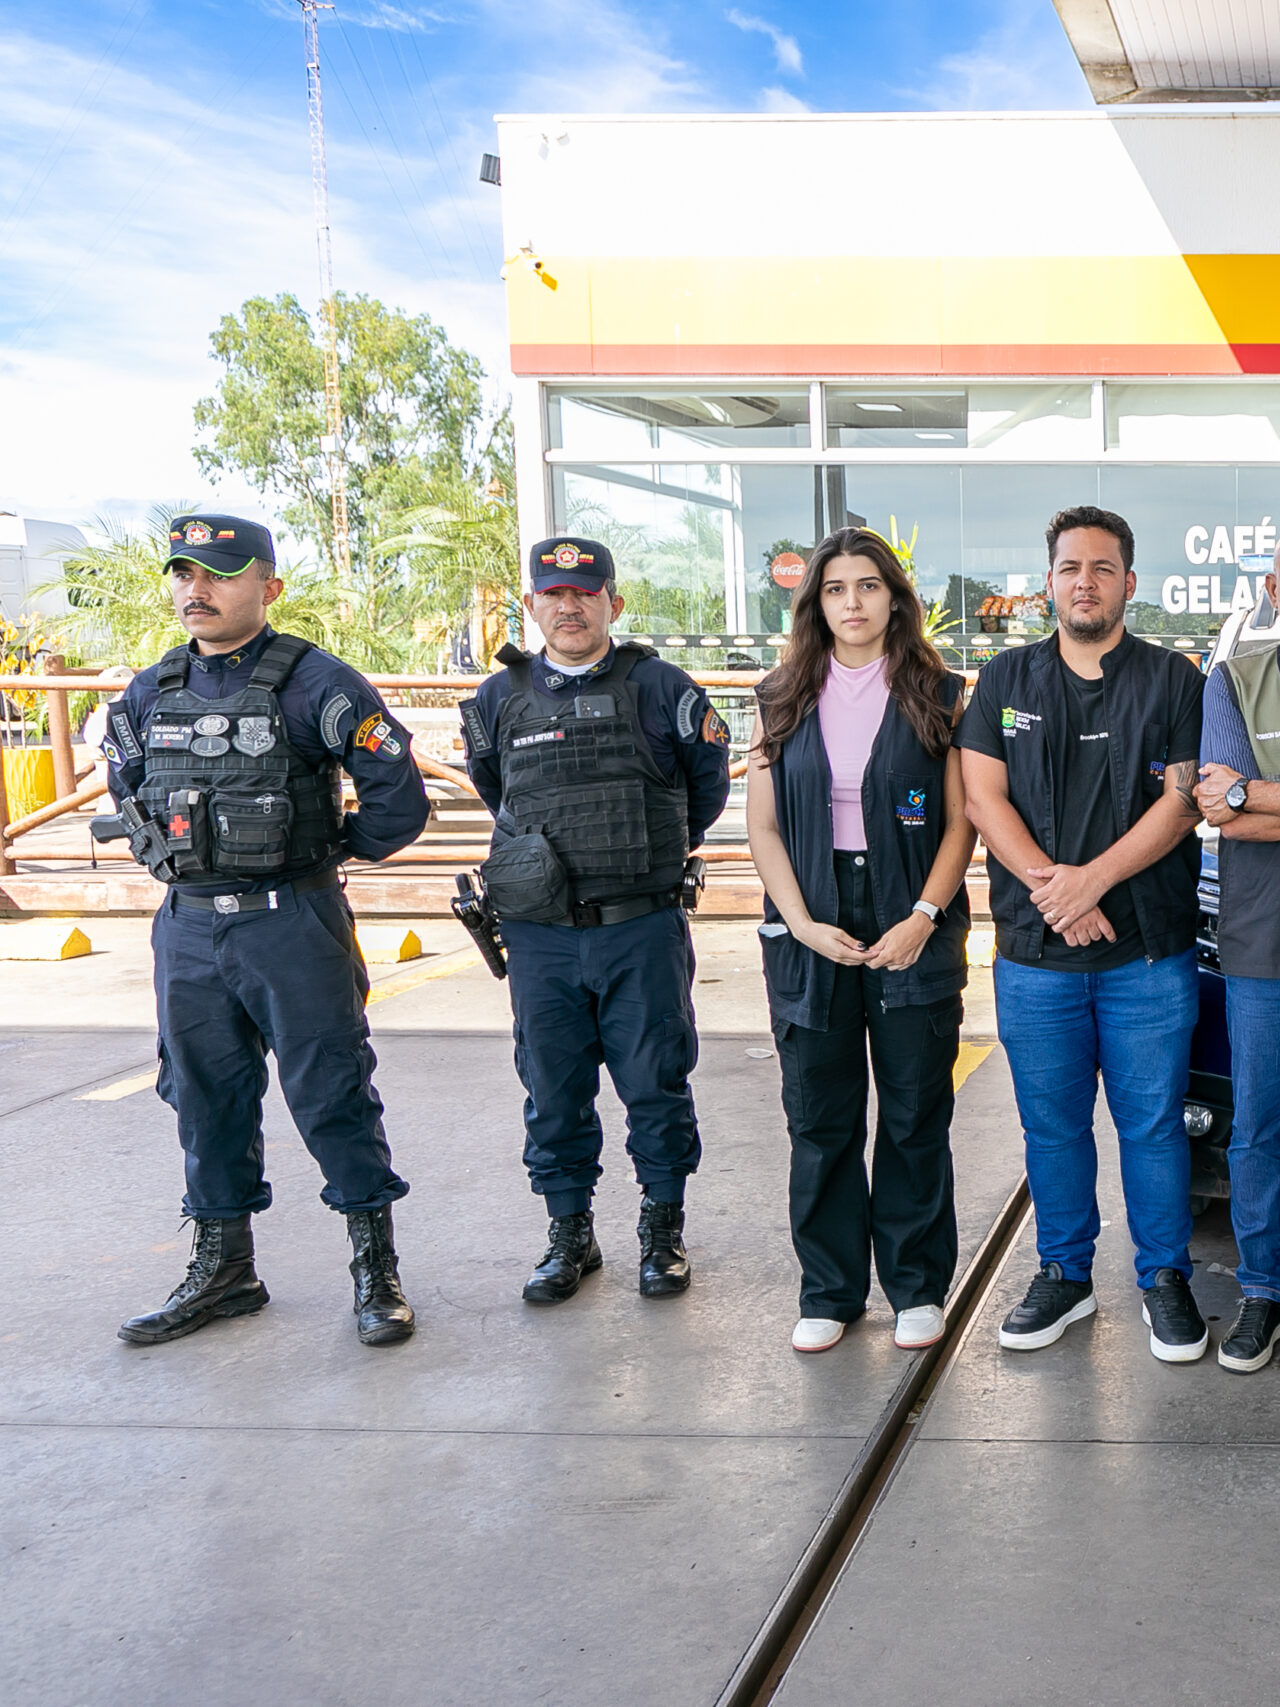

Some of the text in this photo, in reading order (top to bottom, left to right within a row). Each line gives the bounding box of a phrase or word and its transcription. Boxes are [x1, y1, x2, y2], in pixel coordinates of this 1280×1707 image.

[1184, 516, 1275, 564] CAFÉ
[115, 717, 137, 756] PMMT
[466, 710, 486, 747] PMMT
